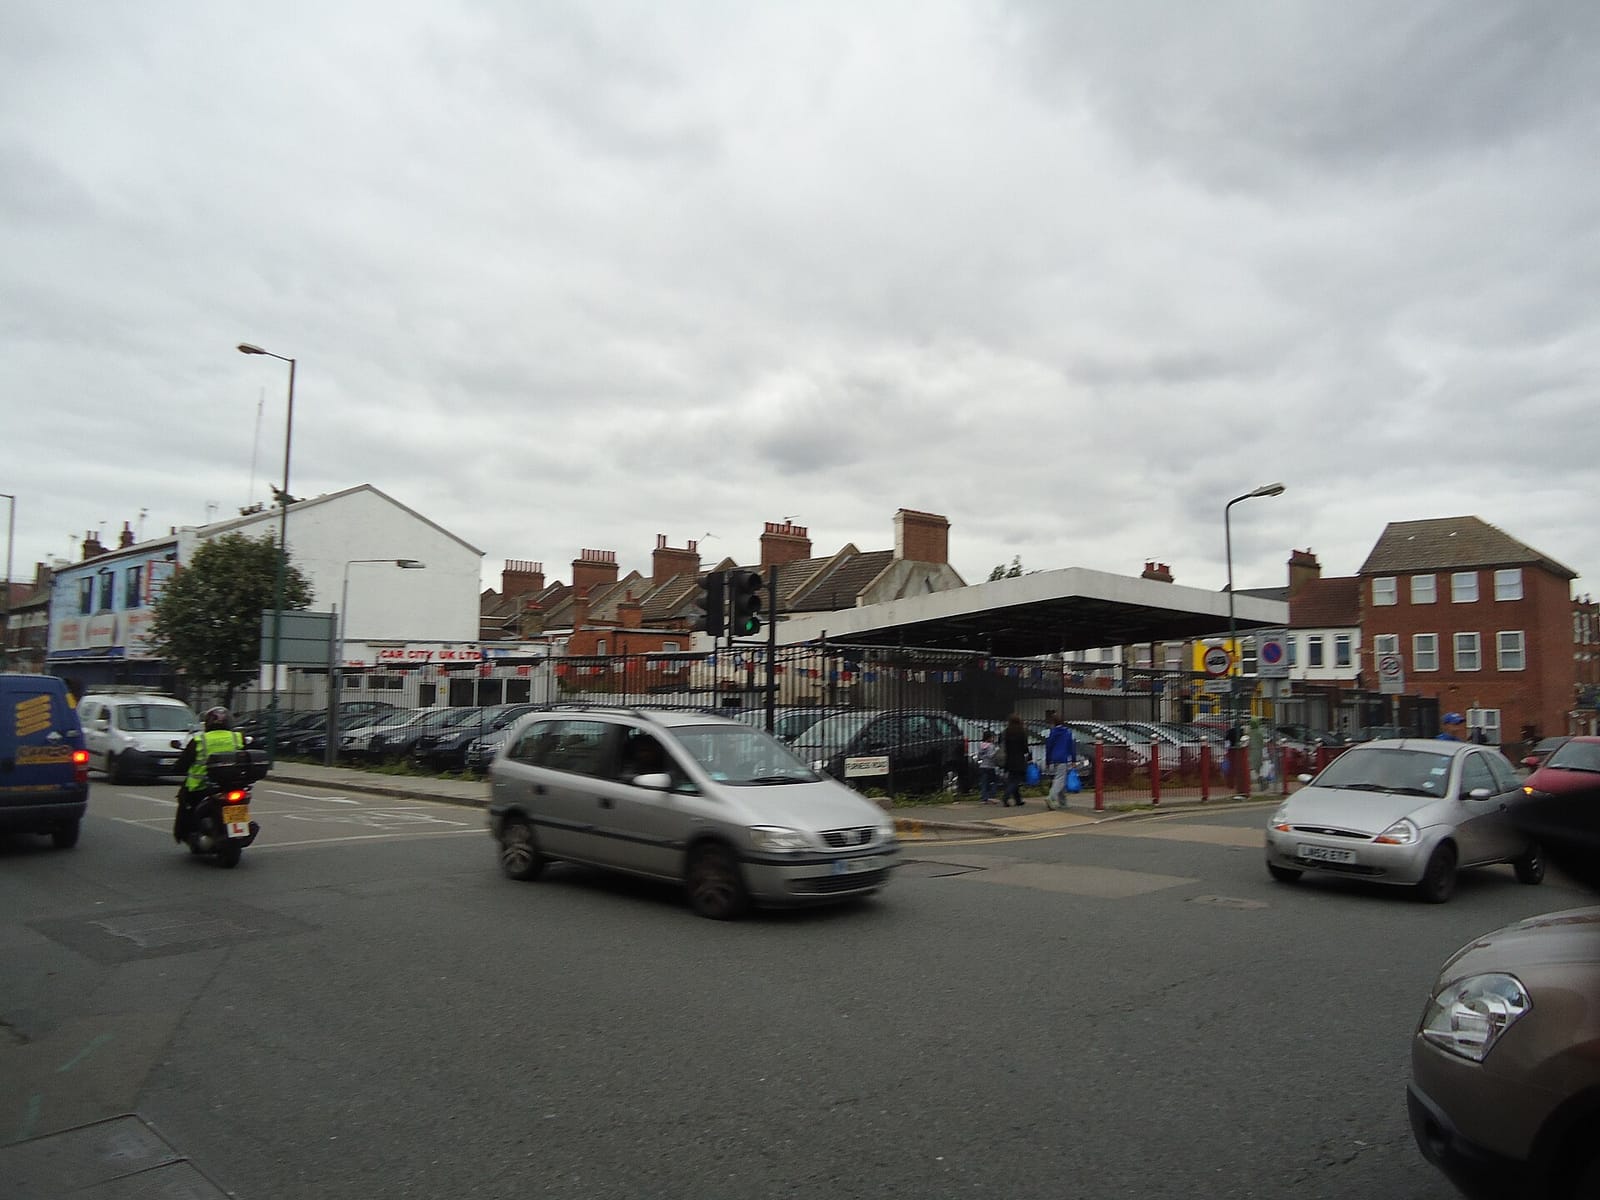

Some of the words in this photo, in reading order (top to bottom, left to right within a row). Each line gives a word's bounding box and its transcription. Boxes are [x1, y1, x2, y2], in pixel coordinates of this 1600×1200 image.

[381, 649, 404, 659] CAR
[407, 650, 434, 660] CITY
[439, 650, 456, 660] UK
[459, 651, 483, 660] LTD
[233, 823, 243, 834] L
